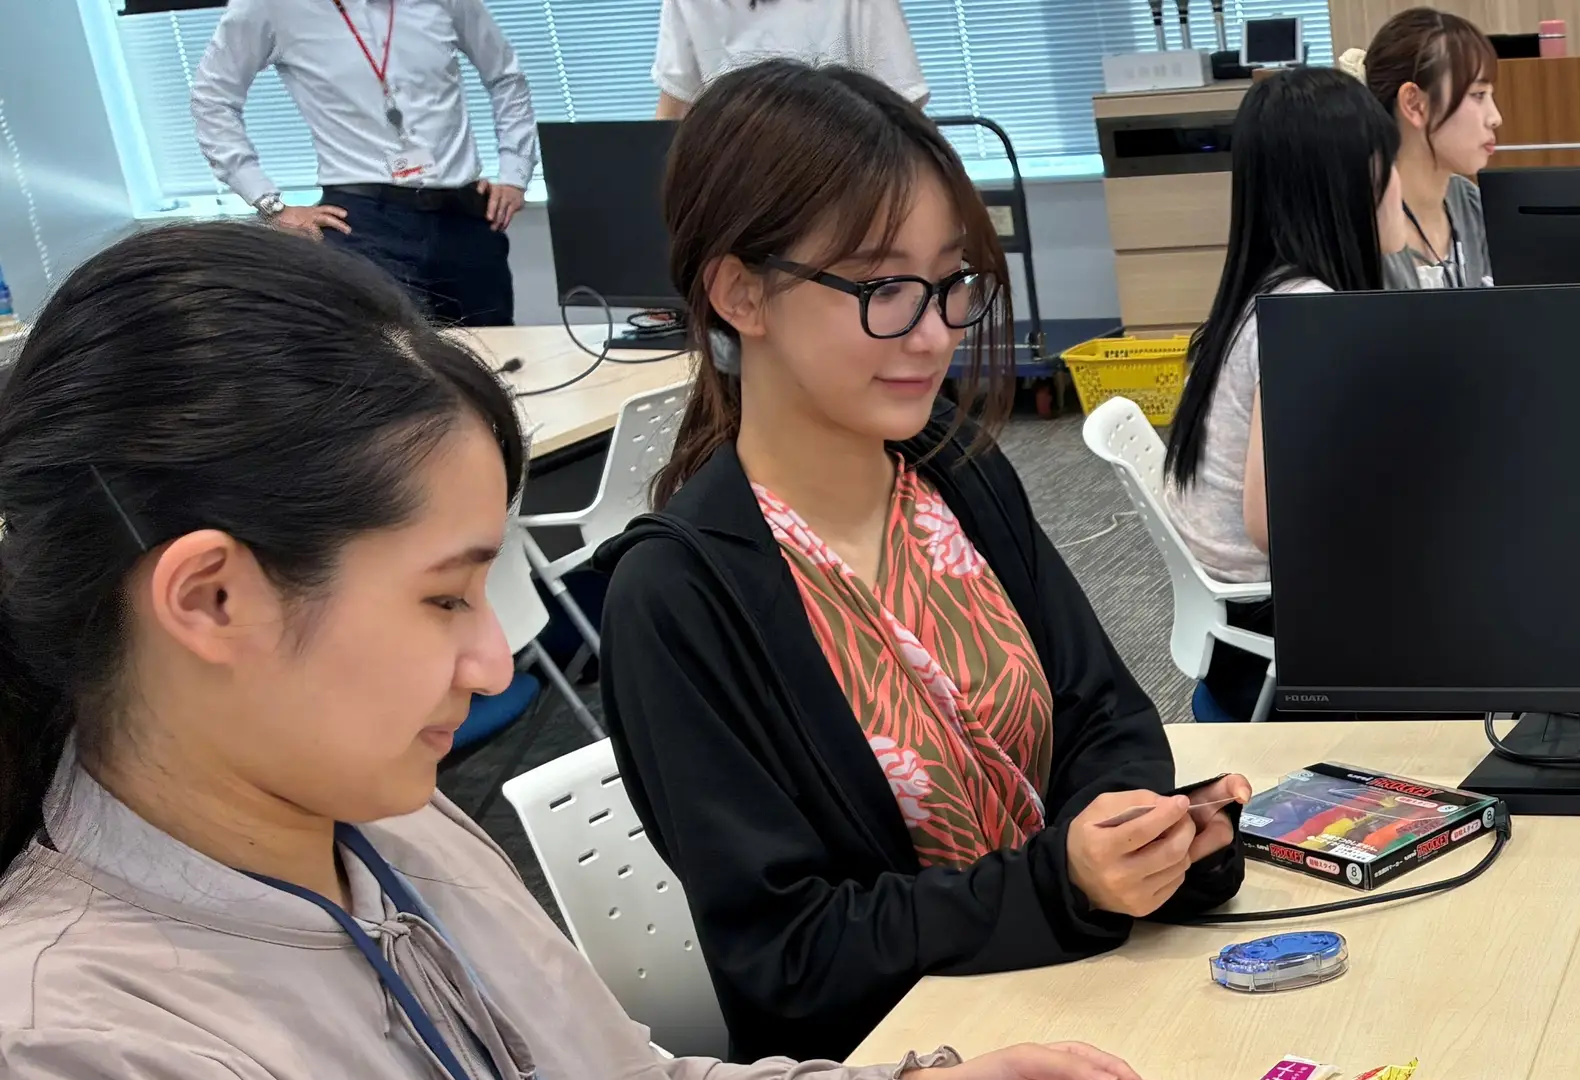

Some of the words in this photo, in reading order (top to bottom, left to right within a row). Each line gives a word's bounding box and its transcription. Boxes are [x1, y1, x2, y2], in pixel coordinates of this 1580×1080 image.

[1370, 777, 1445, 798] PROCKEY
[1270, 844, 1305, 864] PROCKEY
[1417, 831, 1450, 857] PROCKEY
